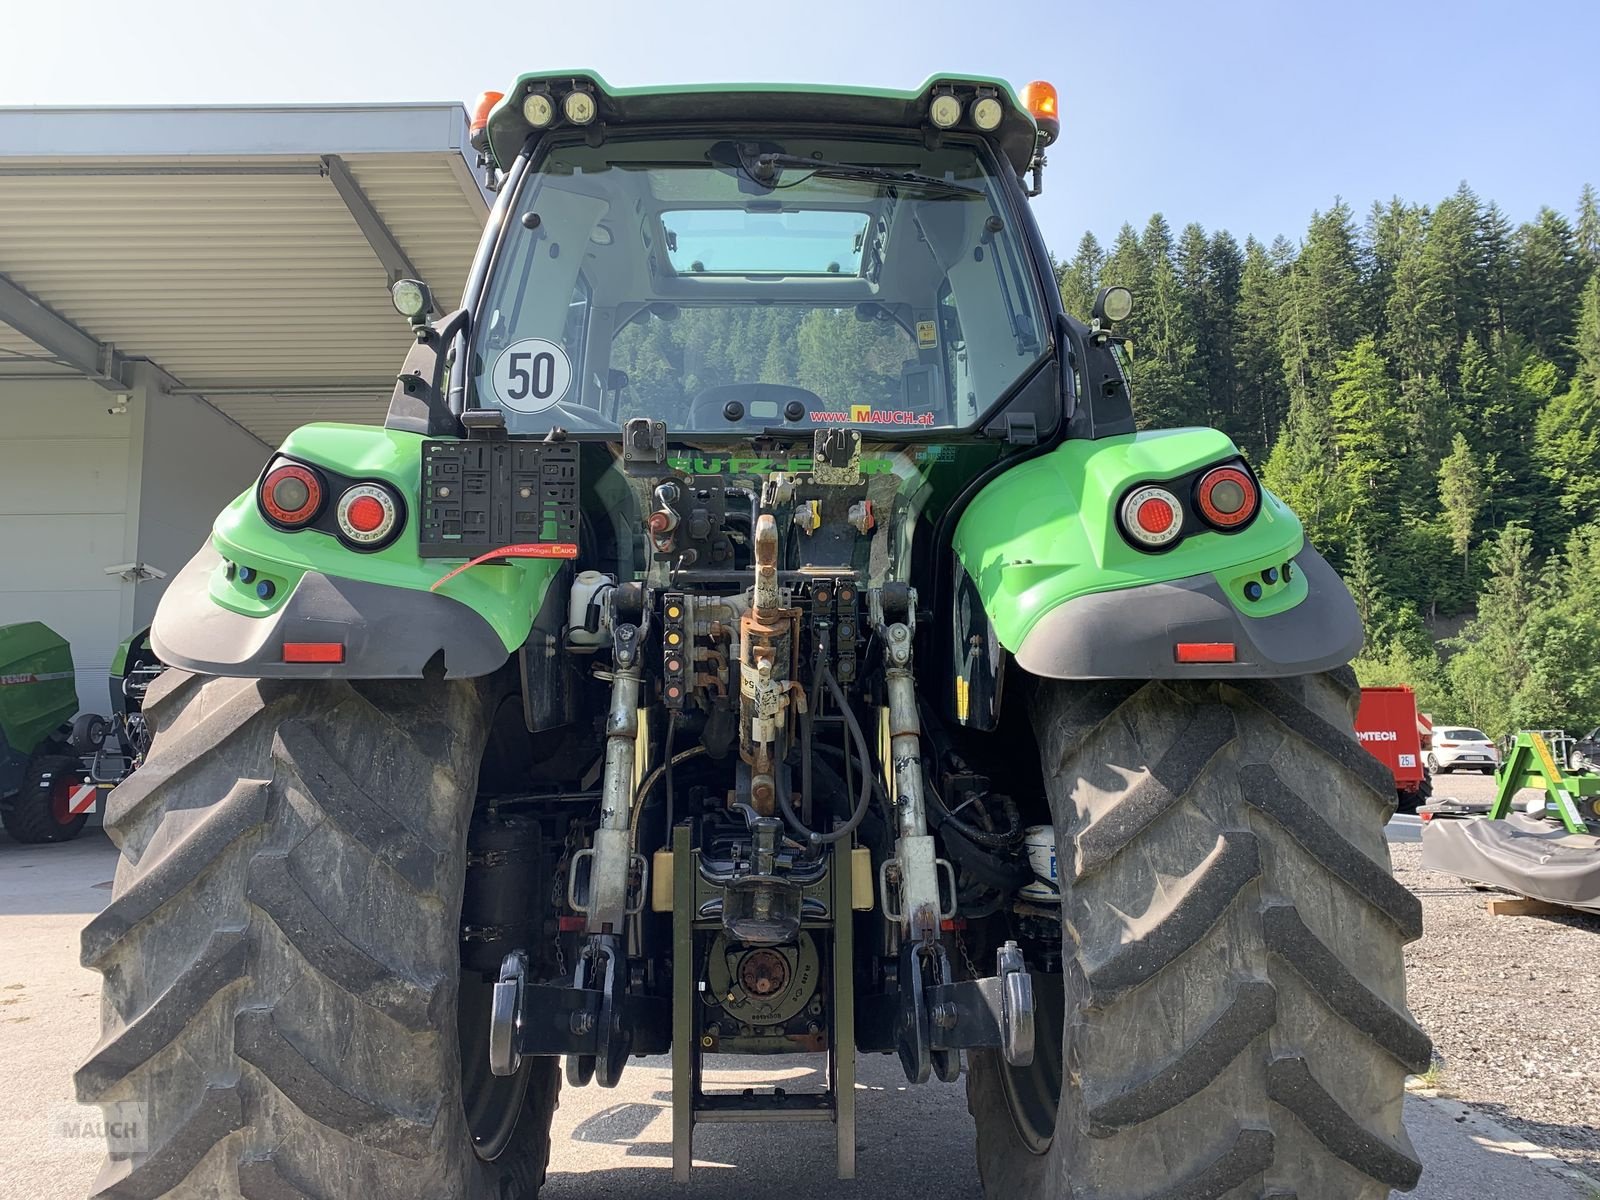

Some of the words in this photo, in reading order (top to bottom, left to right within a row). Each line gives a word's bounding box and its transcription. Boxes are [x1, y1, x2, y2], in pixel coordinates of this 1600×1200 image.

[507, 352, 555, 400] 50
[1, 673, 33, 684] FENDT
[1400, 756, 1409, 766] 25
